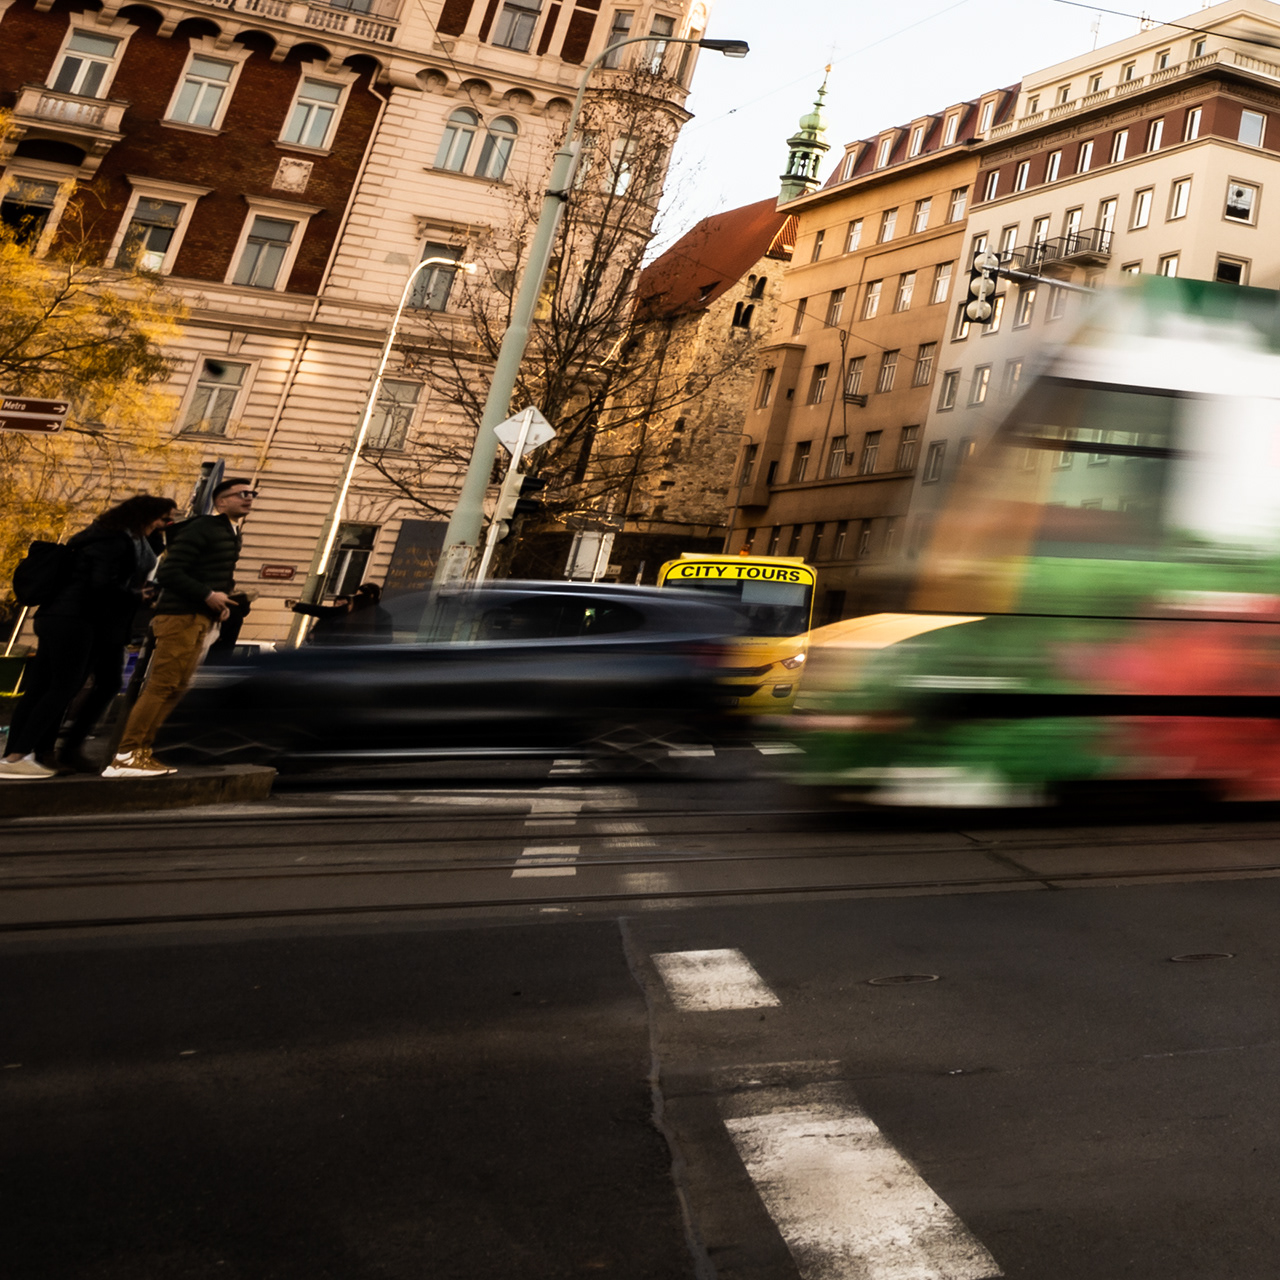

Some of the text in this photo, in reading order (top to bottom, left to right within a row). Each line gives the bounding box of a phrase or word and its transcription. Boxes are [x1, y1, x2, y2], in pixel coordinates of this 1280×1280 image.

[3, 401, 27, 411] Metro
[681, 566, 800, 581] CITY TOURS
